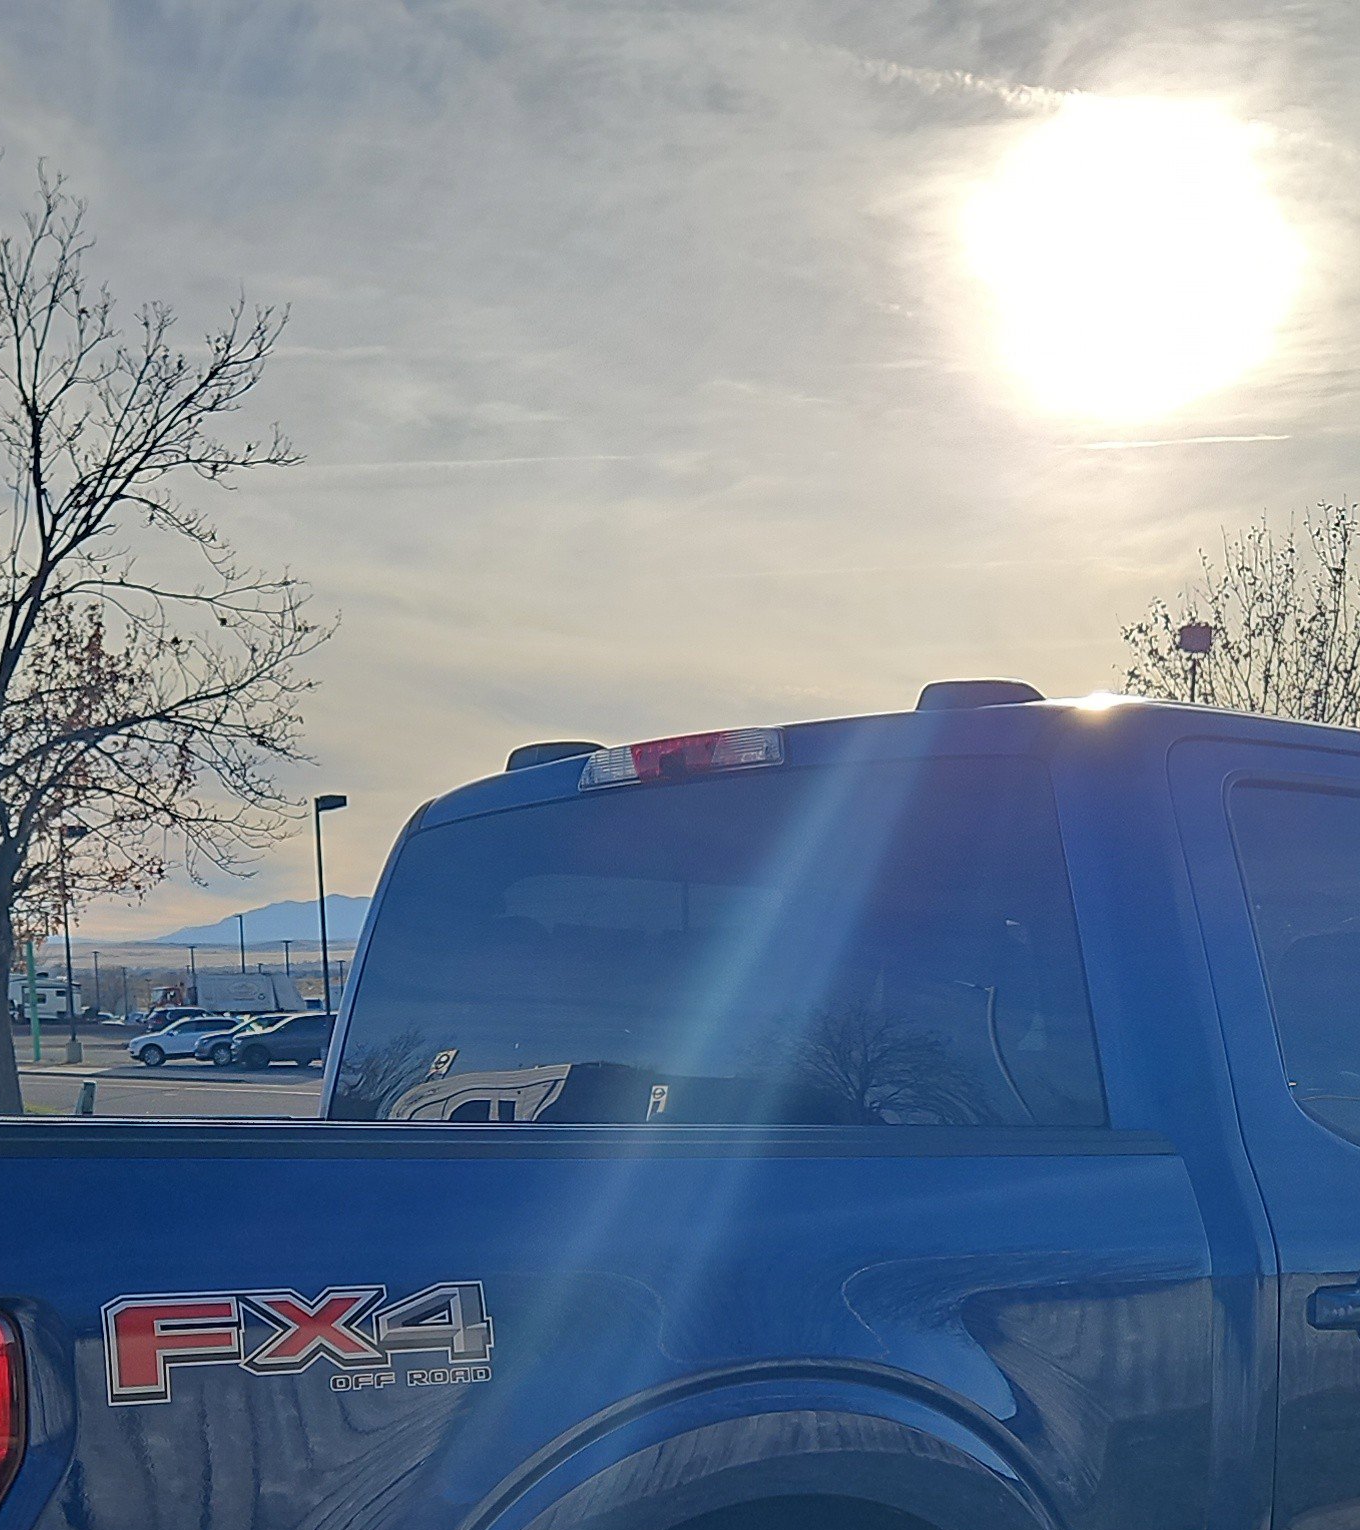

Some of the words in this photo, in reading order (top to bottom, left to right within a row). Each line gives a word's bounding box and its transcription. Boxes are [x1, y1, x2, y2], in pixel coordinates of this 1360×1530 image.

[100, 1281, 494, 1406] FX4
[329, 1372, 397, 1392] OFF
[406, 1365, 493, 1387] ROAD
